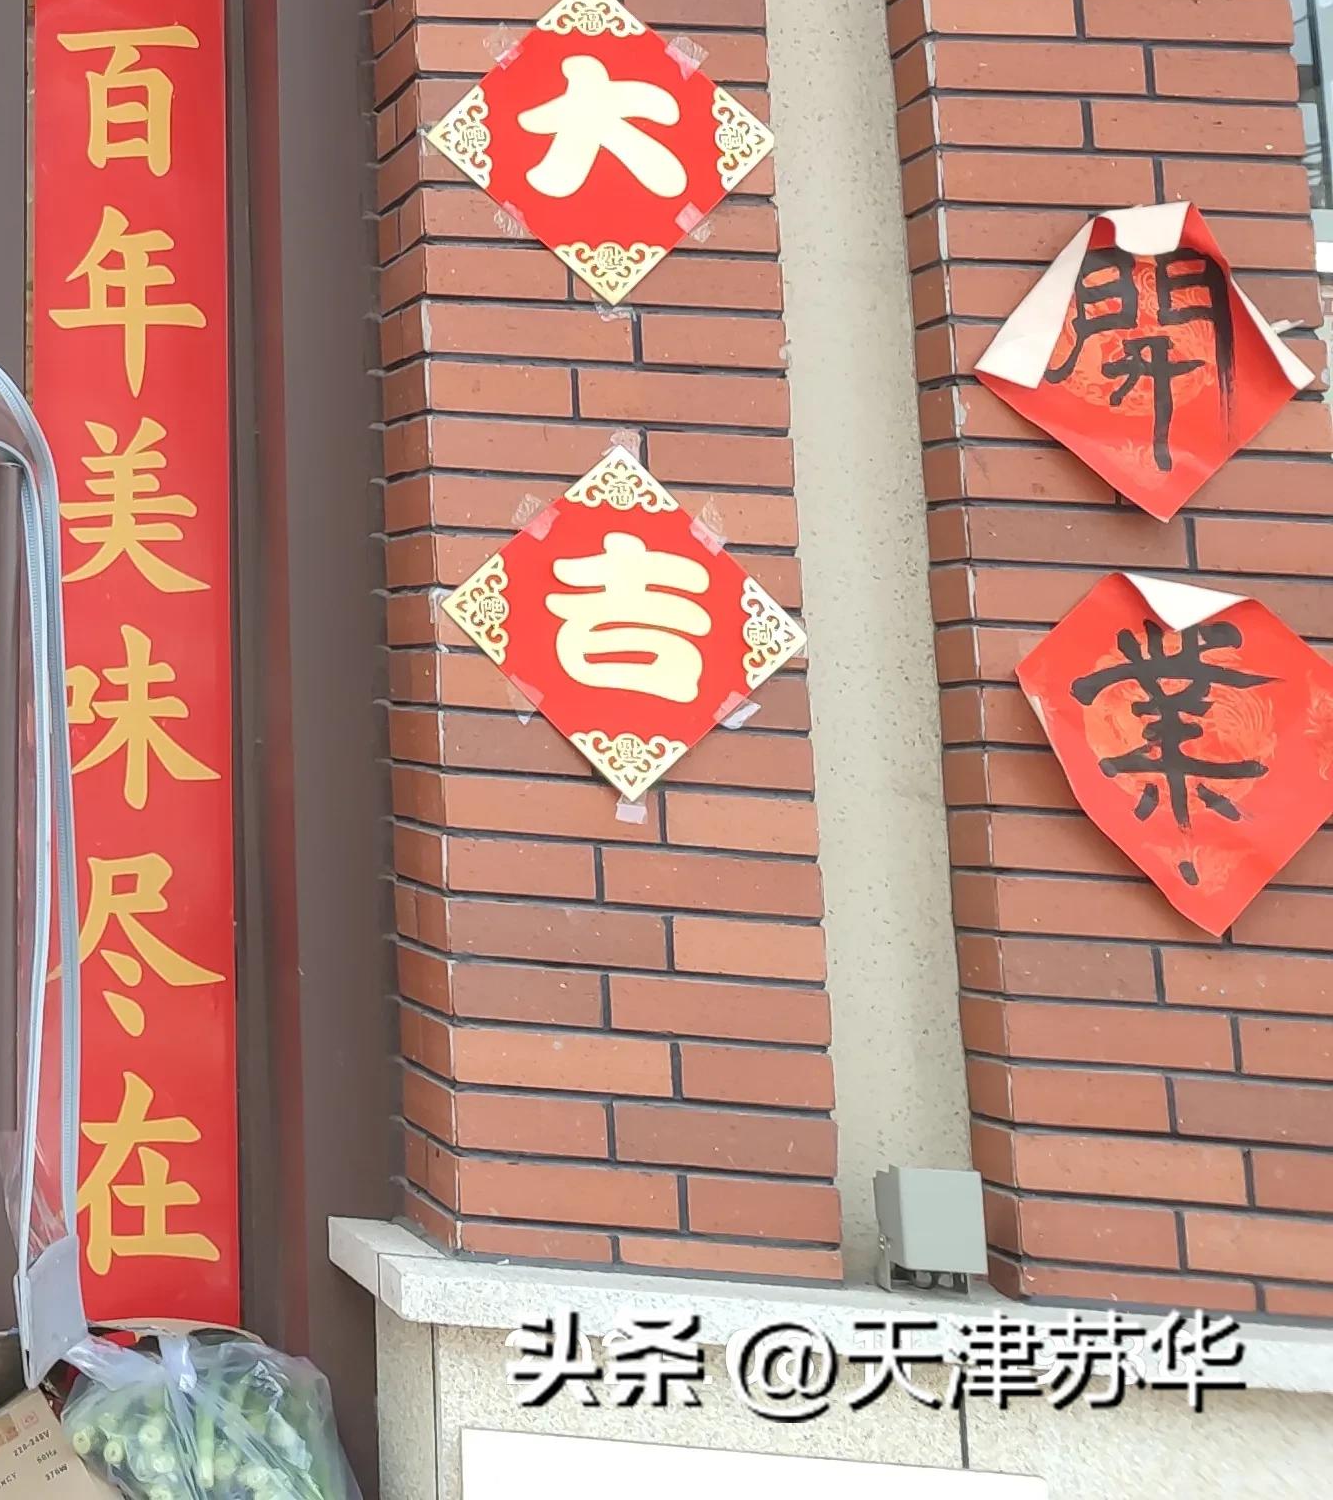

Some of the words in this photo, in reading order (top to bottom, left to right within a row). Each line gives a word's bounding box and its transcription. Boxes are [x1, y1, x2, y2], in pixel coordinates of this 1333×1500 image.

[517, 54, 687, 199] 大
[47, 25, 226, 1290] 百年美味尽在
[546, 532, 712, 704] 吉
